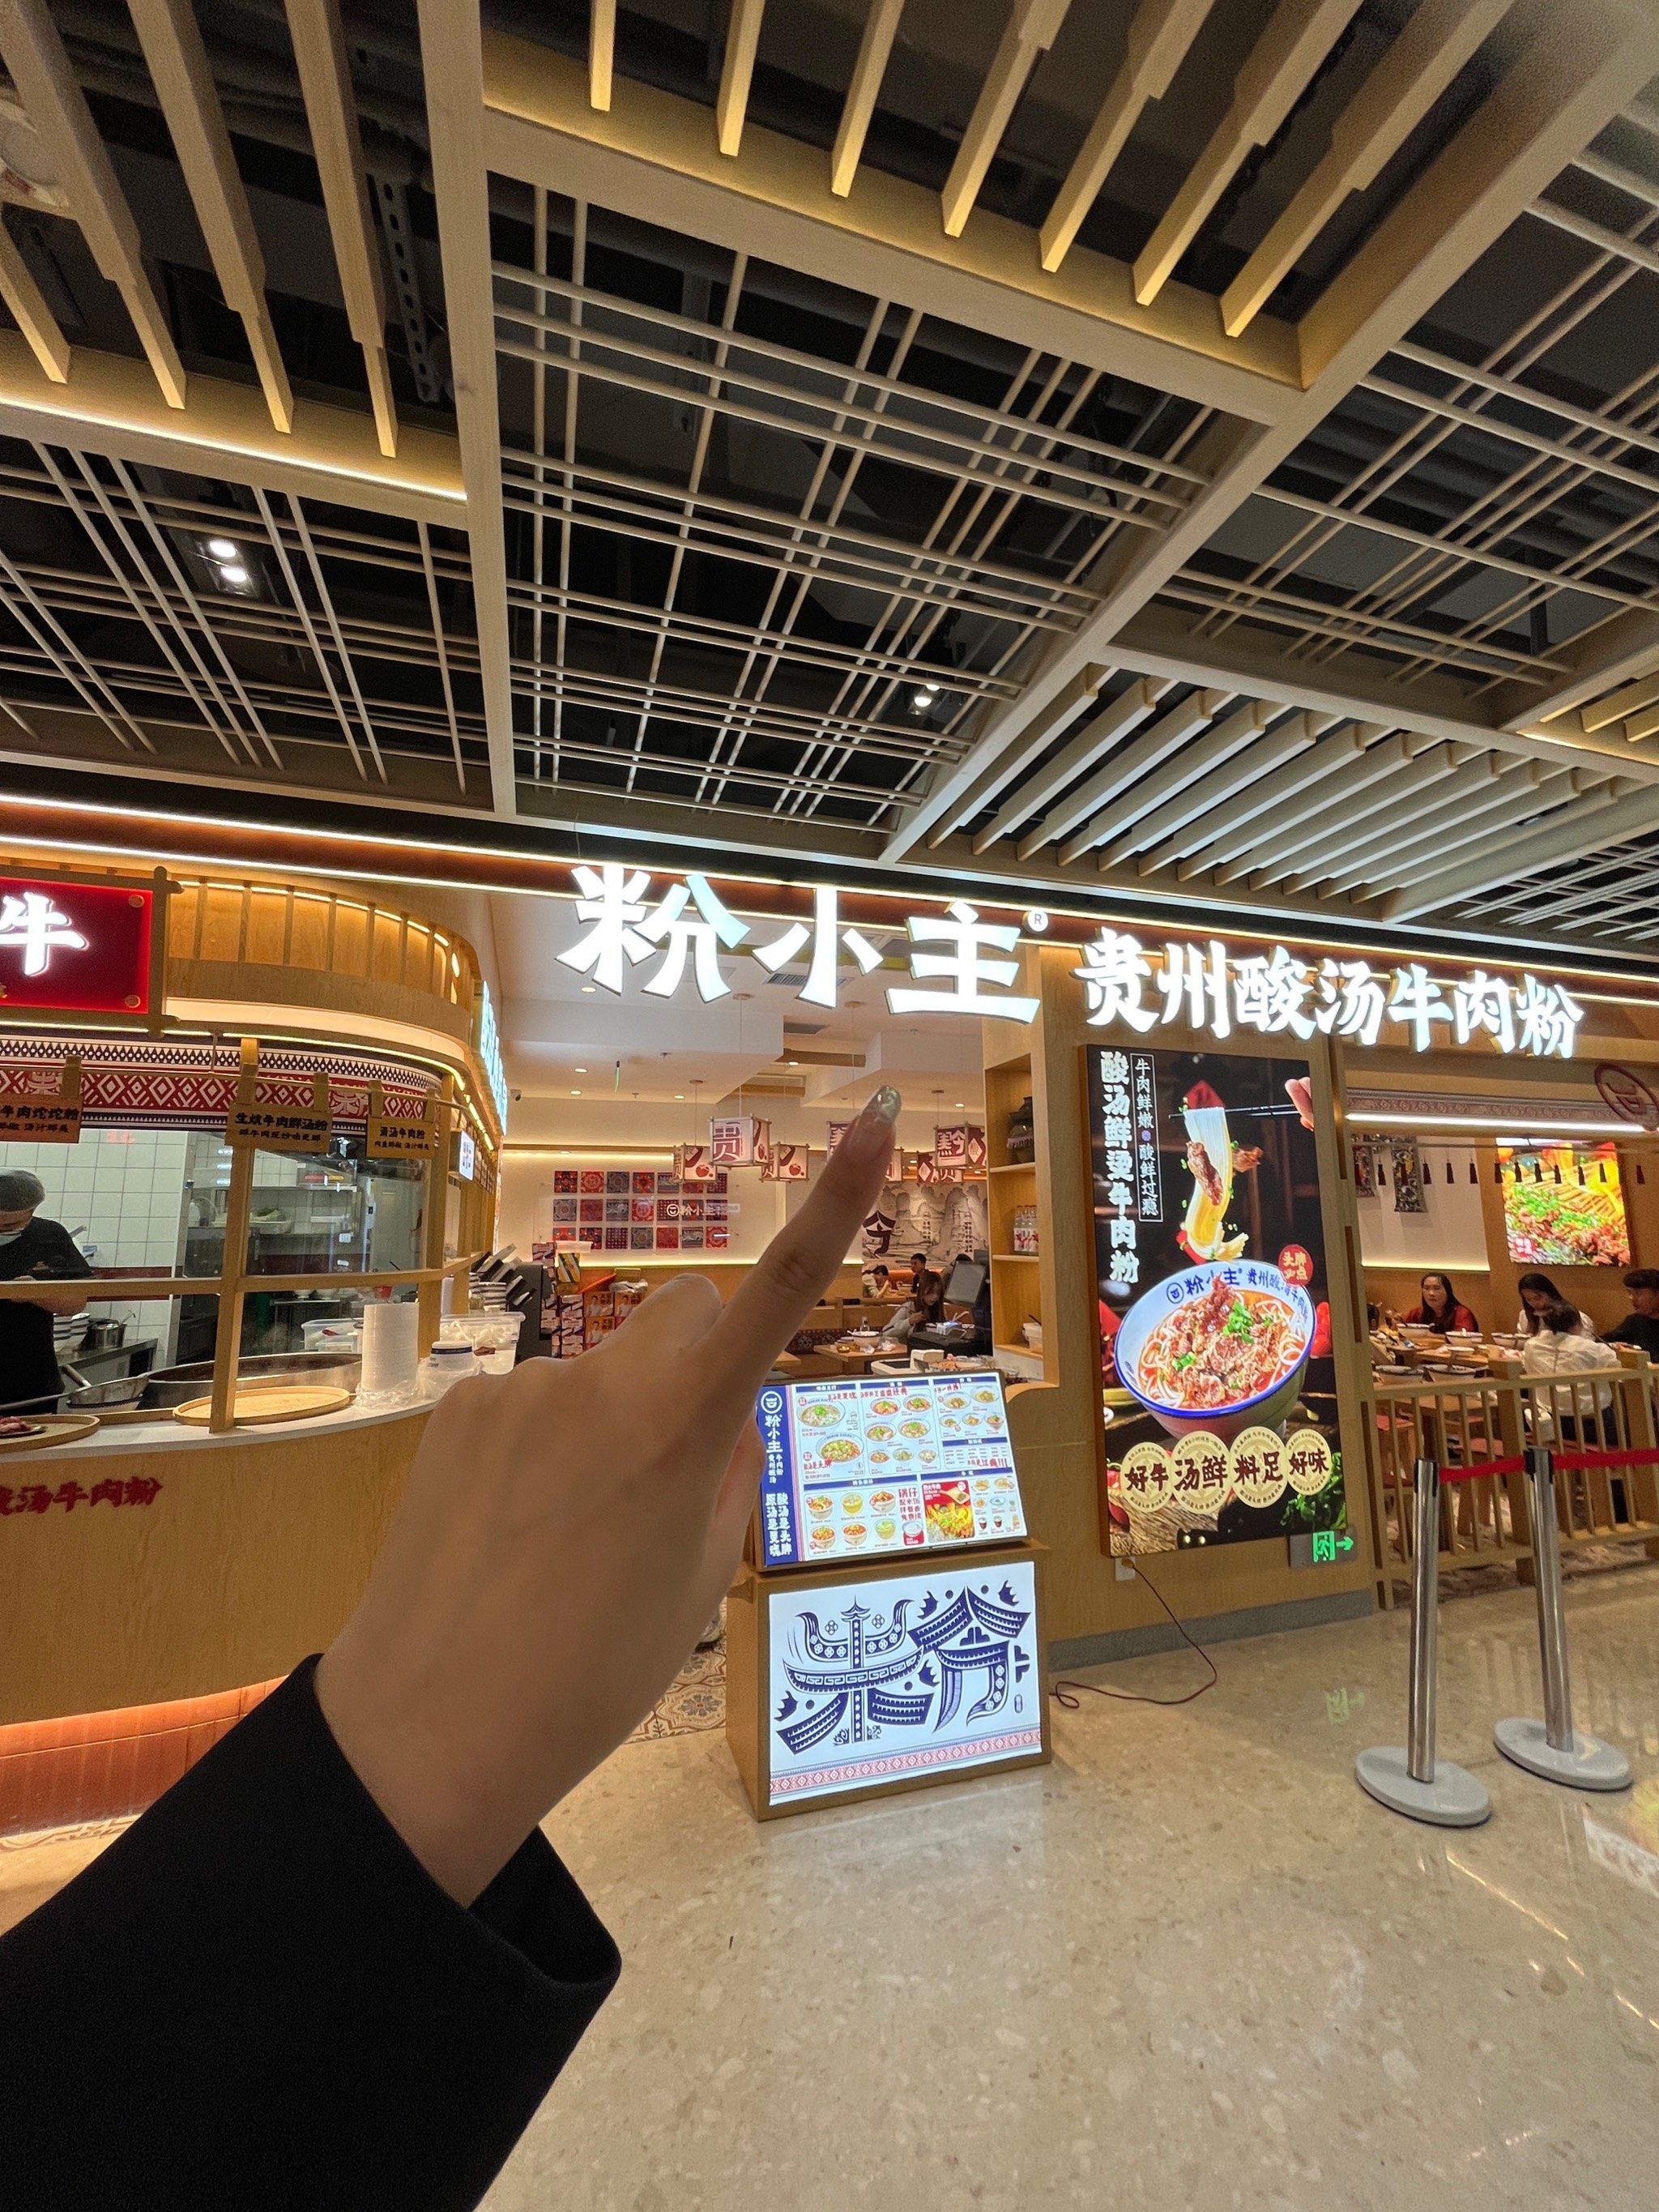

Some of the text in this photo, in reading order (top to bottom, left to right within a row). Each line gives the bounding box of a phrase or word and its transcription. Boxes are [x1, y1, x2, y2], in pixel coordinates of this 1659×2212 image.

[0, 893, 87, 976] 牛
[1075, 926, 1585, 1059] 贵州酸汤牛肉粉
[1135, 1057, 1154, 1129] 牛肉鲜嫩
[1124, 1463, 1169, 1493] 好牛
[1174, 1454, 1228, 1491] 汤鲜
[1233, 1451, 1283, 1485] 料足
[1288, 1448, 1329, 1477] 好味
